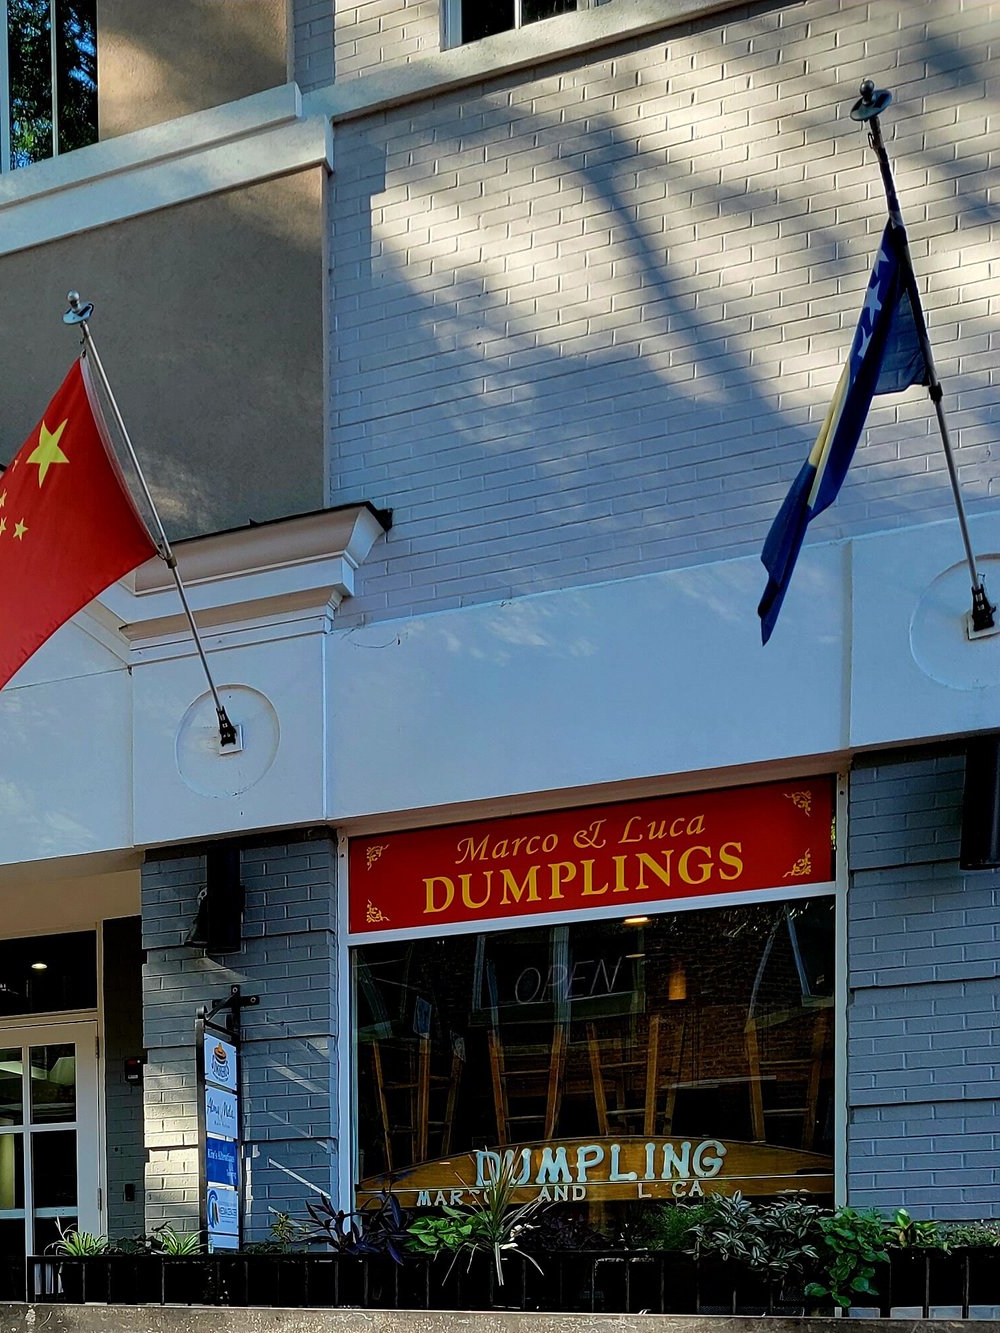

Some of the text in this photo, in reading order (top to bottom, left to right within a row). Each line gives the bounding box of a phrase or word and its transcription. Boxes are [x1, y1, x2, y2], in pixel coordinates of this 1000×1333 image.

[455, 814, 706, 865] Marco & Luca
[422, 841, 744, 913] DUMPLINGS
[514, 955, 623, 1004] OPEN
[475, 1139, 728, 1187] DUMPLING
[537, 1184, 587, 1202] AND
[637, 1179, 704, 1199] LCA
